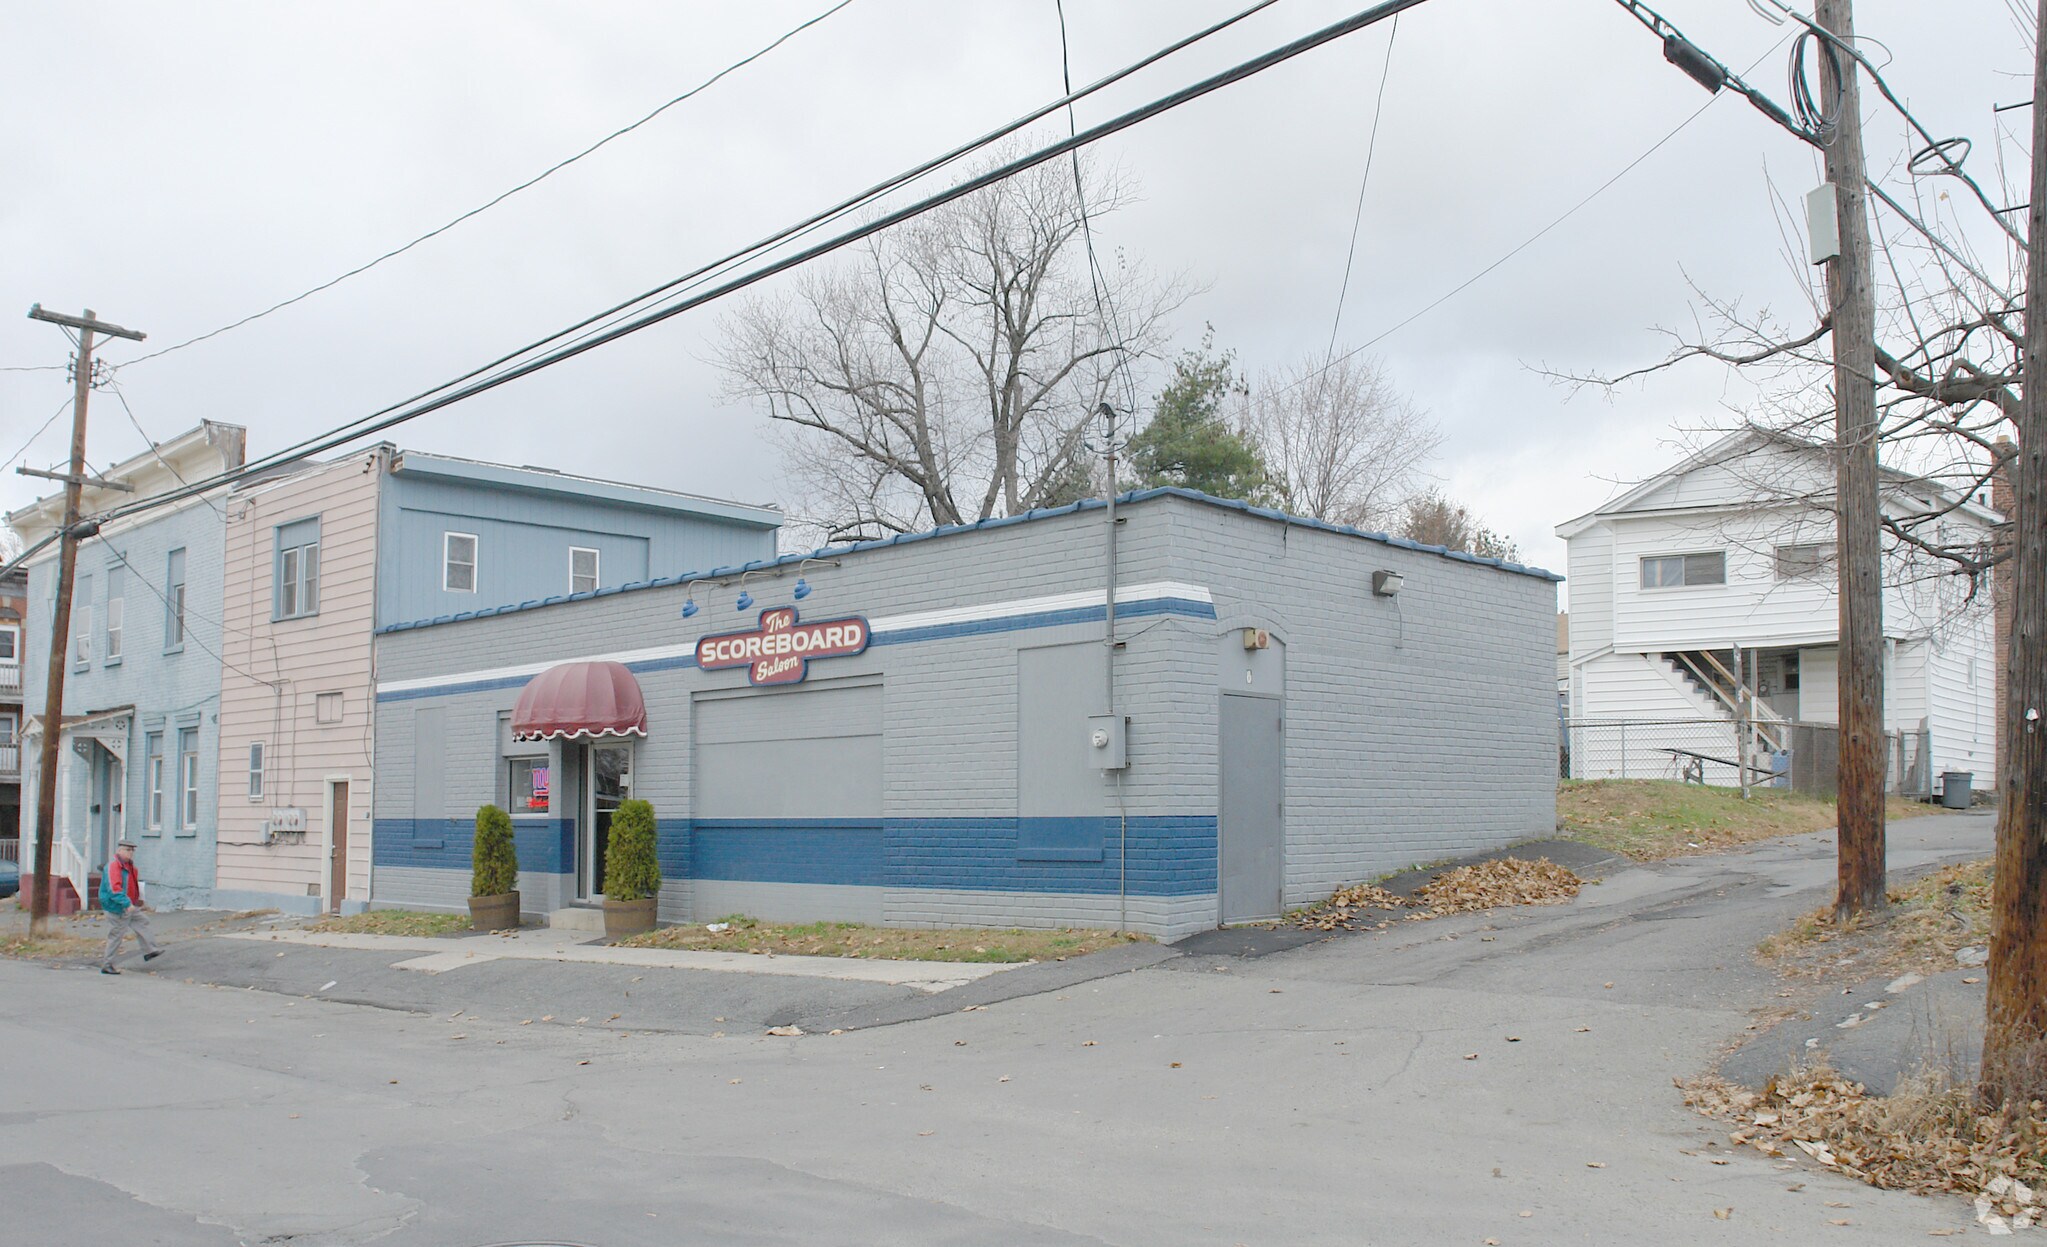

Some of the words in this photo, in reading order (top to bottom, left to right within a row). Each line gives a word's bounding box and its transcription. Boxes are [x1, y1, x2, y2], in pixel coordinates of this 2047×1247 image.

[766, 612, 790, 633] The
[702, 625, 861, 662] SCOREBOARD
[757, 656, 798, 681] Saloon
